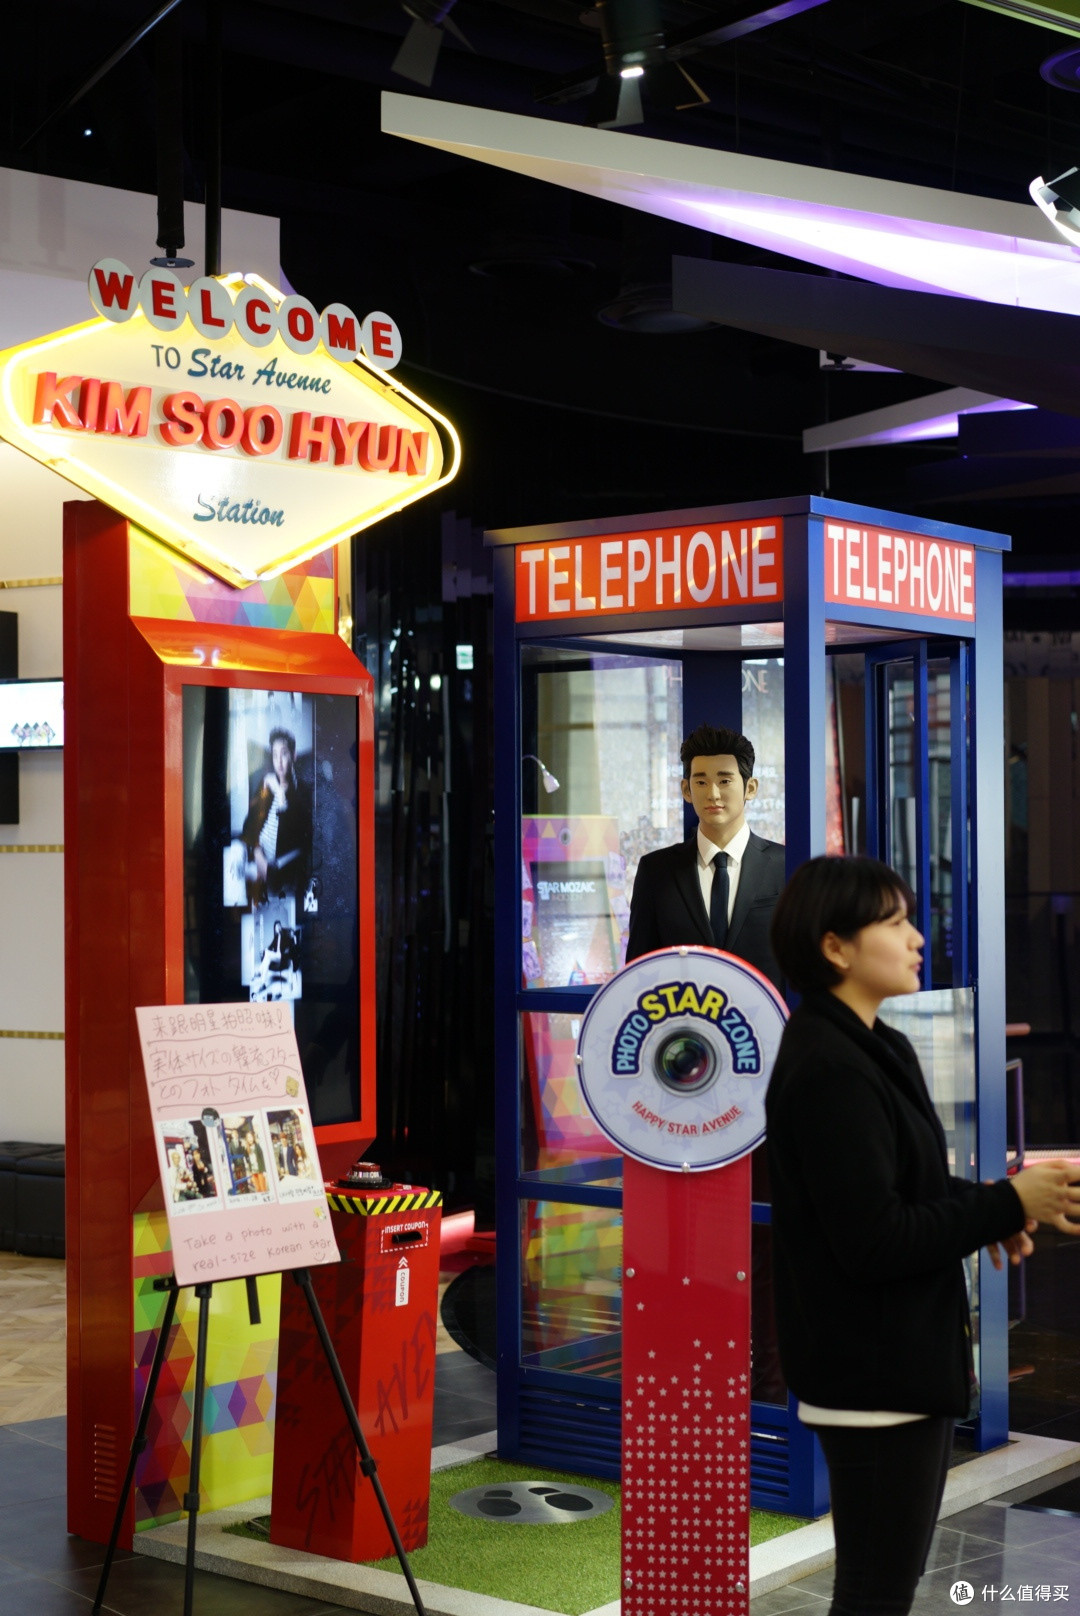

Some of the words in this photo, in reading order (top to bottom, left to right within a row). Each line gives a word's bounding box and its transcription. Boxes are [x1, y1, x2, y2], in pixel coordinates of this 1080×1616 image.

[93, 268, 396, 359] WELCOME
[150, 344, 181, 370] TO
[187, 347, 247, 380] Star
[33, 370, 154, 438] KIM
[159, 390, 284, 458] SOO
[288, 411, 430, 476] HYUN
[193, 493, 286, 528] Station
[520, 525, 778, 615] TELEPHONE
[827, 525, 975, 616] TELEPHONE
[537, 881, 560, 894] STAR
[616, 1013, 650, 1072] PHOTO
[641, 985, 725, 1022] STAR
[721, 1010, 758, 1071] ZONE
[632, 1100, 667, 1130] HAPPY
[667, 1122, 698, 1135] STAR
[702, 1105, 742, 1135] AVENUE
[183, 1233, 216, 1251] Take
[225, 1231, 233, 1241] a
[241, 1226, 272, 1241] photo
[282, 1220, 306, 1234] with
[312, 1220, 320, 1230] a
[192, 1250, 256, 1272] real-size
[267, 1242, 303, 1257] Korean
[309, 1238, 332, 1249] star
